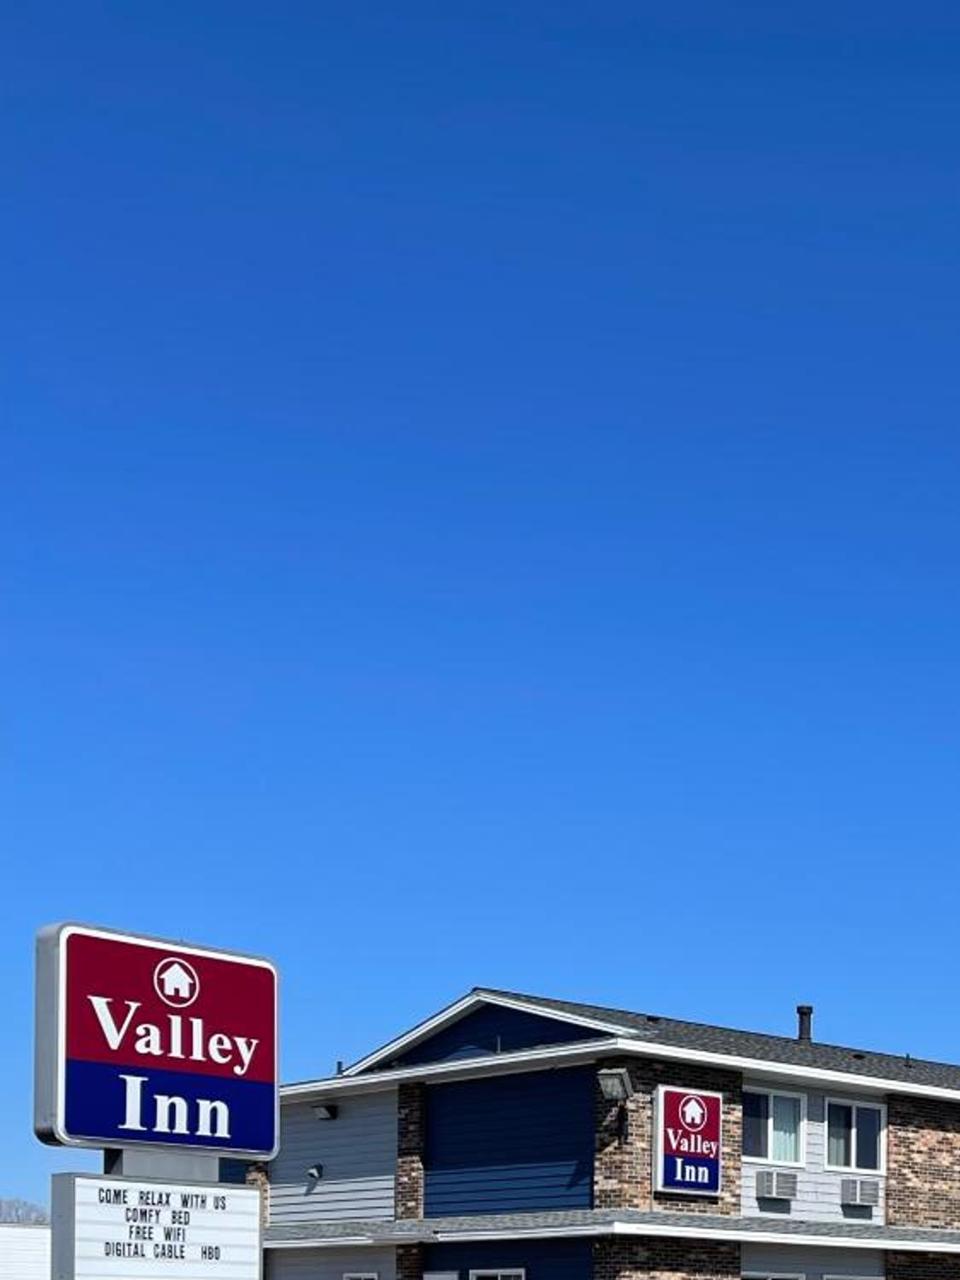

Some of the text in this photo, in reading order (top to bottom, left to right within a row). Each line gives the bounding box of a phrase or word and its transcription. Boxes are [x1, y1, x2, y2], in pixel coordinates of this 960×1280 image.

[87, 995, 260, 1075] Valley
[118, 1075, 231, 1138] Inn
[666, 1128, 718, 1158] Valley
[675, 1158, 709, 1182] Inn
[98, 1188, 226, 1210] COME RELAX WITH US
[125, 1208, 190, 1225] COMFY BED
[128, 1226, 186, 1242] FREE WIFI
[104, 1242, 220, 1260] DIGITAL CABLE HBO
